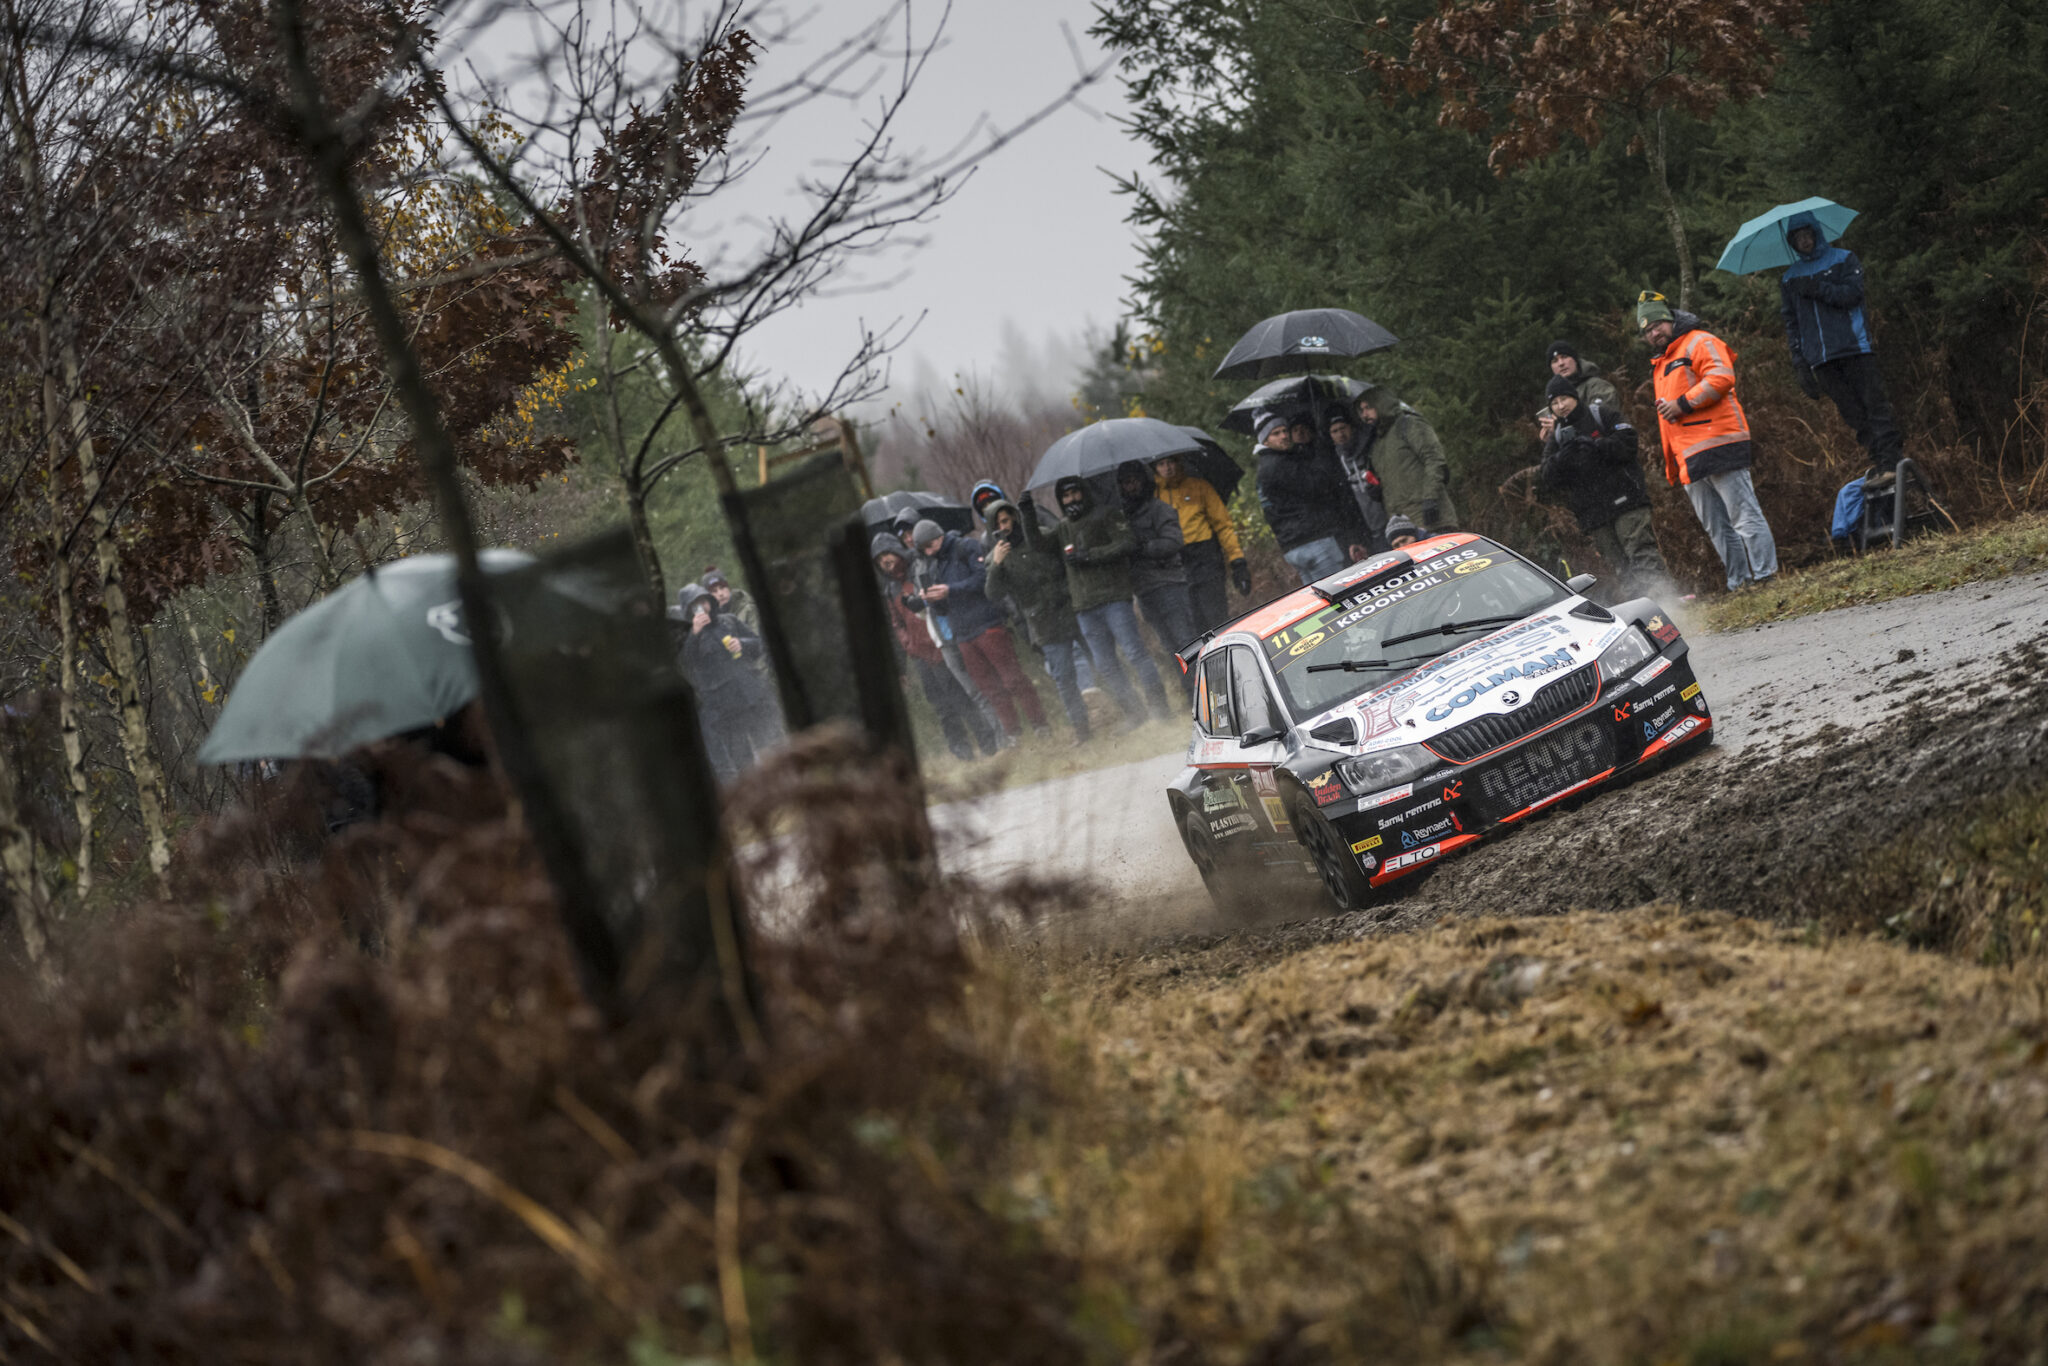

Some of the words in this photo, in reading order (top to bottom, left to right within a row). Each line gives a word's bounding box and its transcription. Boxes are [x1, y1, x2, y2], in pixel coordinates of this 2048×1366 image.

[1353, 549, 1479, 605] BROTHERS
[1336, 577, 1442, 628] KROON-OIL
[1271, 630, 1291, 649] 11
[1425, 647, 1574, 722] COLMAN
[1652, 705, 1675, 730] Reynaert
[1663, 718, 1696, 742] ELTO
[1479, 722, 1601, 798] RENVO
[1314, 782, 1343, 798] Gulden
[1317, 793, 1342, 807] Draak
[1377, 813, 1404, 831] Samy
[1413, 817, 1453, 840] Reynaert
[1354, 836, 1381, 852] PIRELLI
[1386, 846, 1436, 873] ELTO
